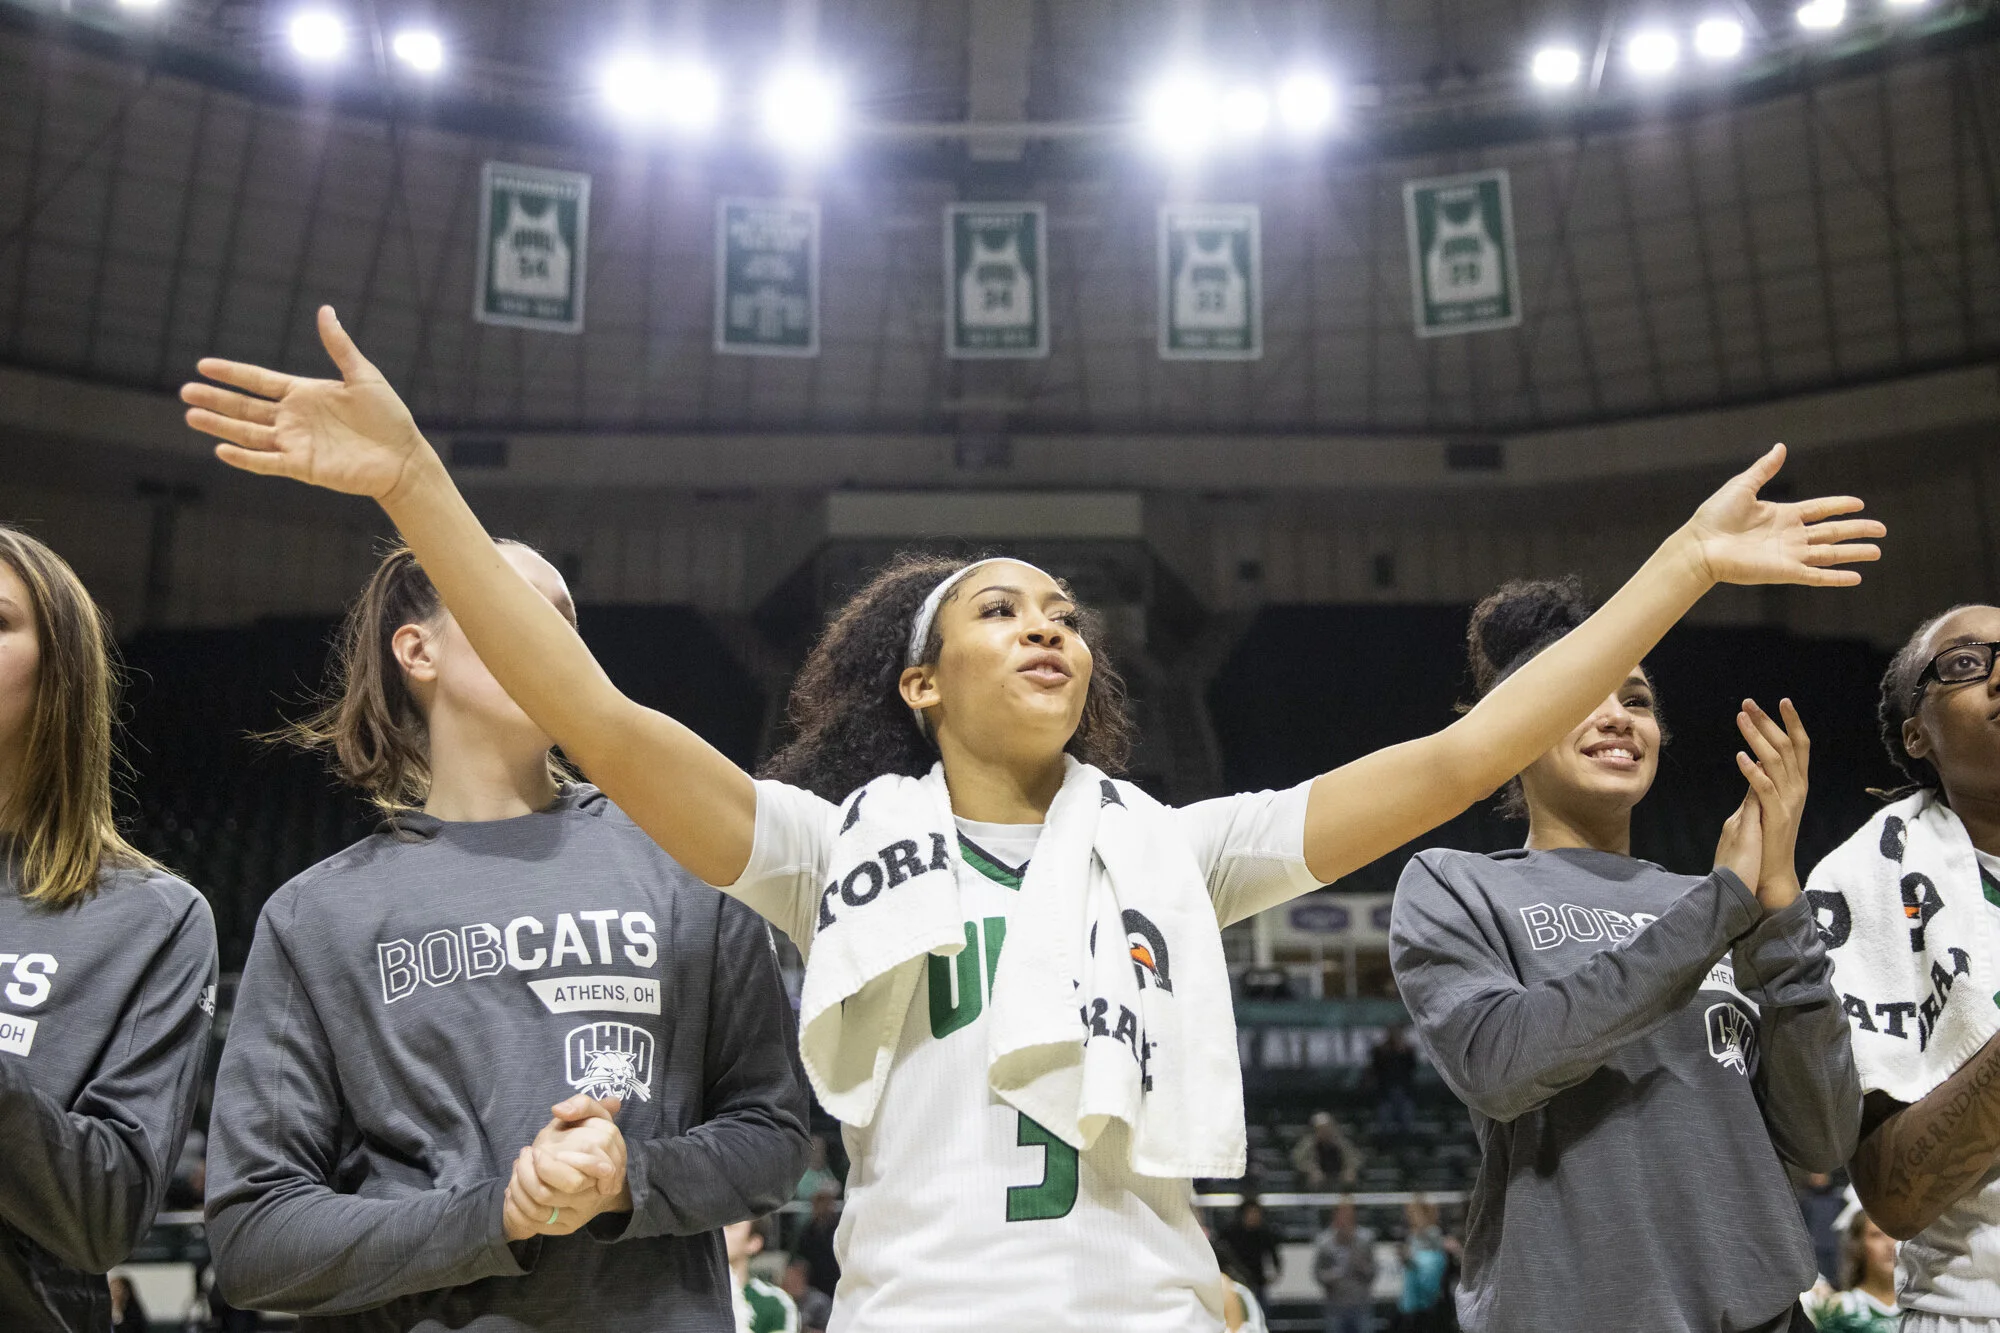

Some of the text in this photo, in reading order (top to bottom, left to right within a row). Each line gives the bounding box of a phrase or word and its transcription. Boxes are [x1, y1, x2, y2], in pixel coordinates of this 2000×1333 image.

[377, 909, 658, 1004] BOBCATS
[554, 984, 655, 1003] ATHENS, OH
